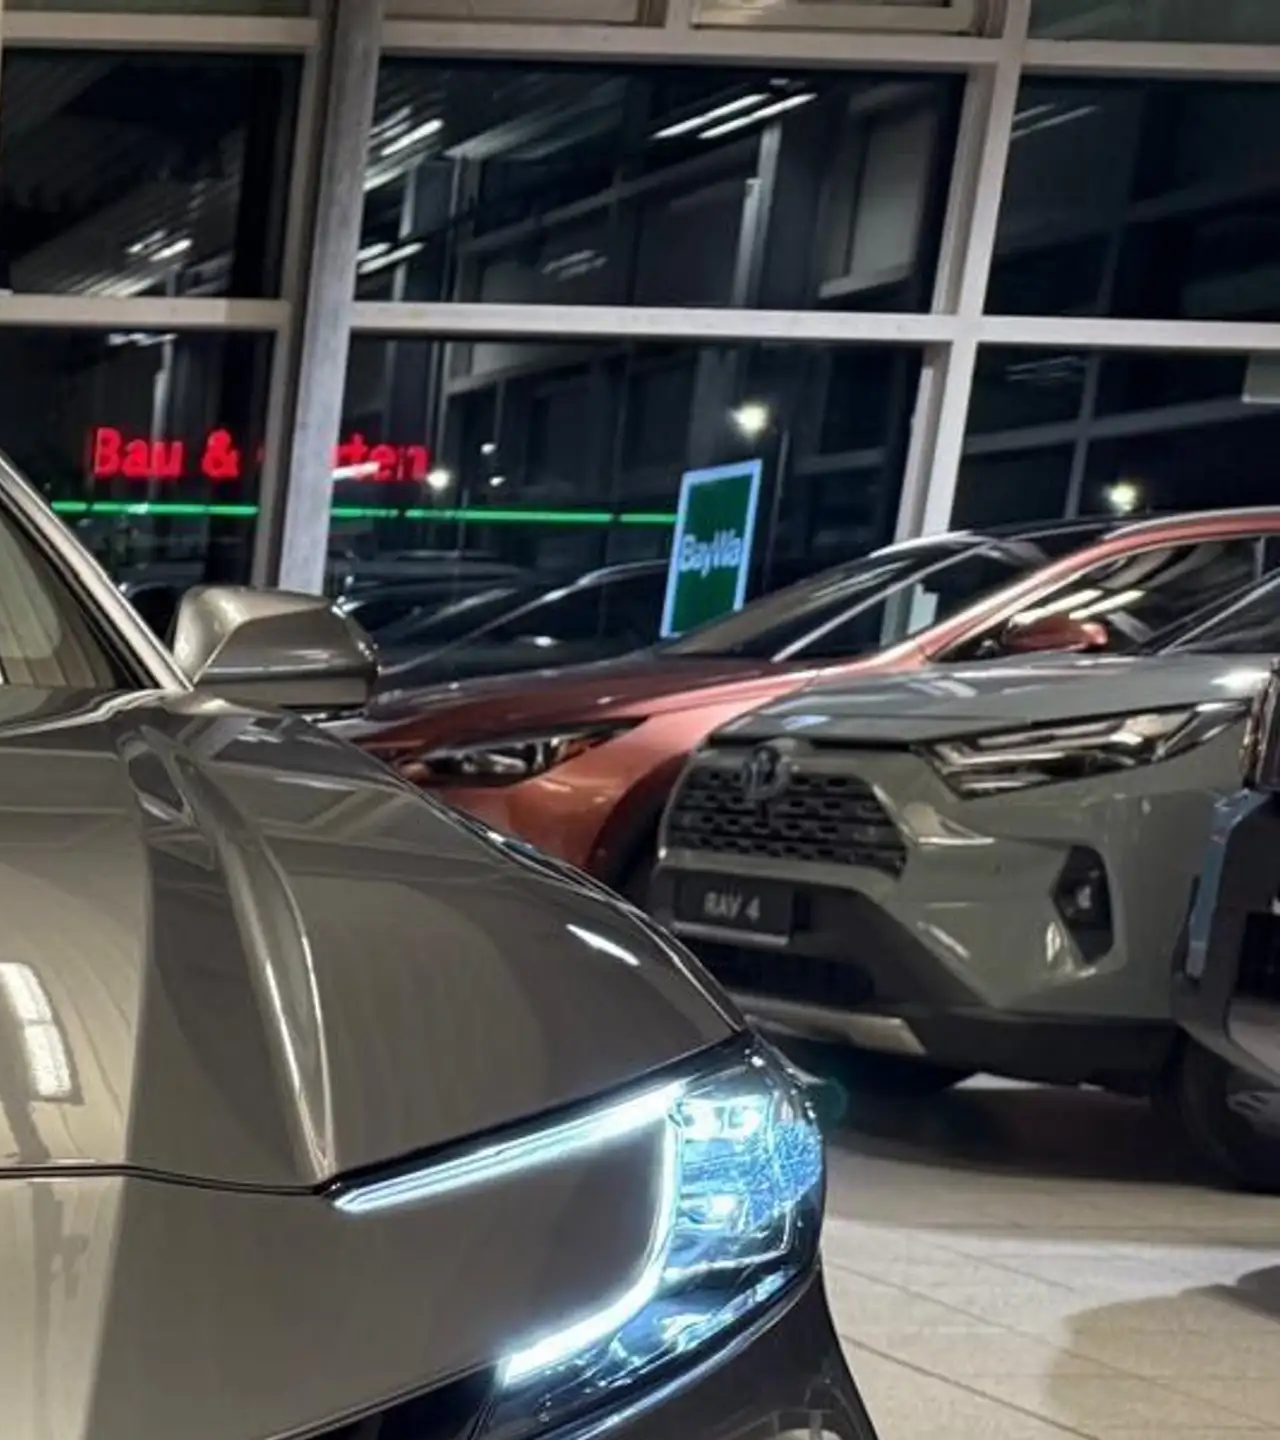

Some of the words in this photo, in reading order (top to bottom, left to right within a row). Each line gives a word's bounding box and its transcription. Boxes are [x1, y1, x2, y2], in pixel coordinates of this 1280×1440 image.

[94, 427, 182, 477] Bau
[202, 428, 239, 477] &
[704, 891, 743, 919] RAV
[744, 896, 761, 922] 4
